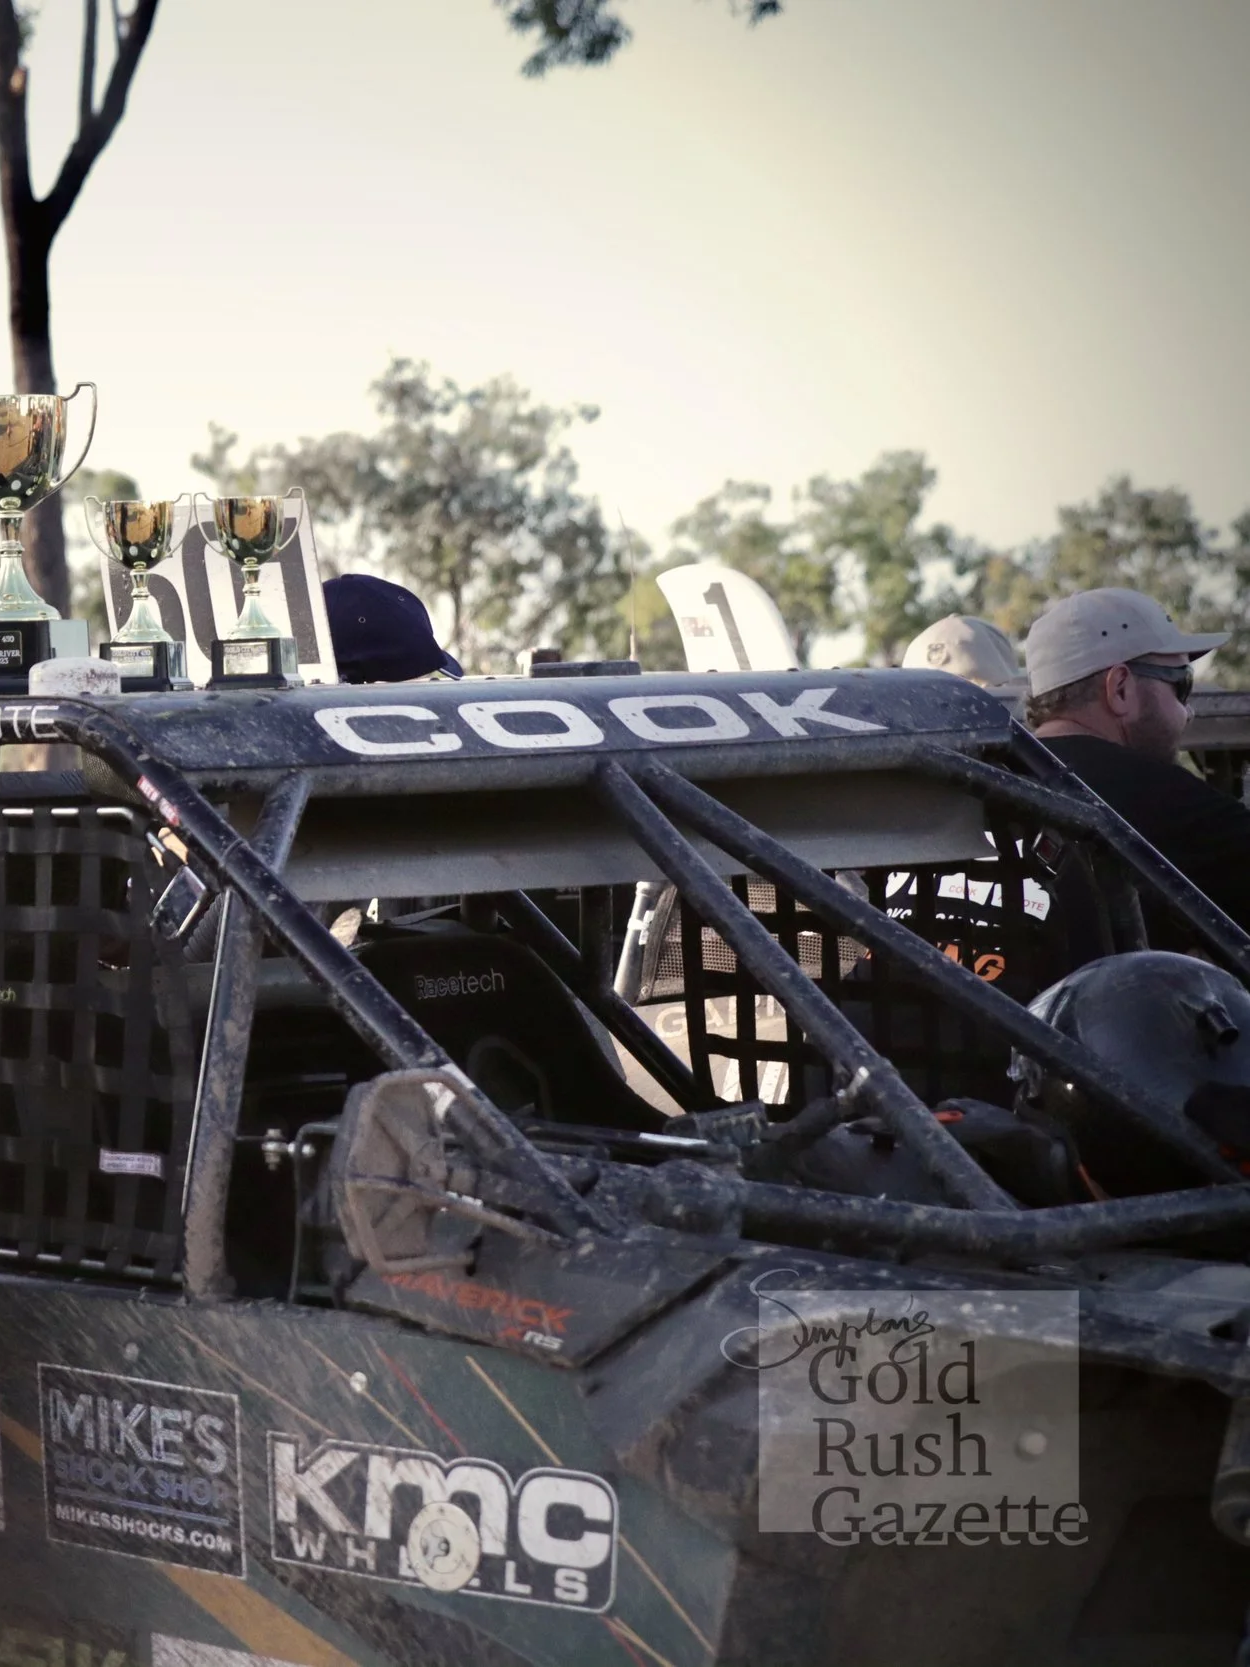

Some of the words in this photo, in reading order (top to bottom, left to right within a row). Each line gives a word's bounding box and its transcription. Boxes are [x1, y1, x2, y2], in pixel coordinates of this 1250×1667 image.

[702, 582, 753, 671] 1
[313, 687, 889, 757] COOK
[414, 967, 506, 1001] Racetech
[49, 1388, 227, 1474] MIKE'S
[52, 1452, 149, 1496] SHOCK
[153, 1469, 232, 1510] SHOP
[54, 1503, 233, 1553] MIKESSHOCKS.COM
[289, 1526, 588, 1603] WHLS
